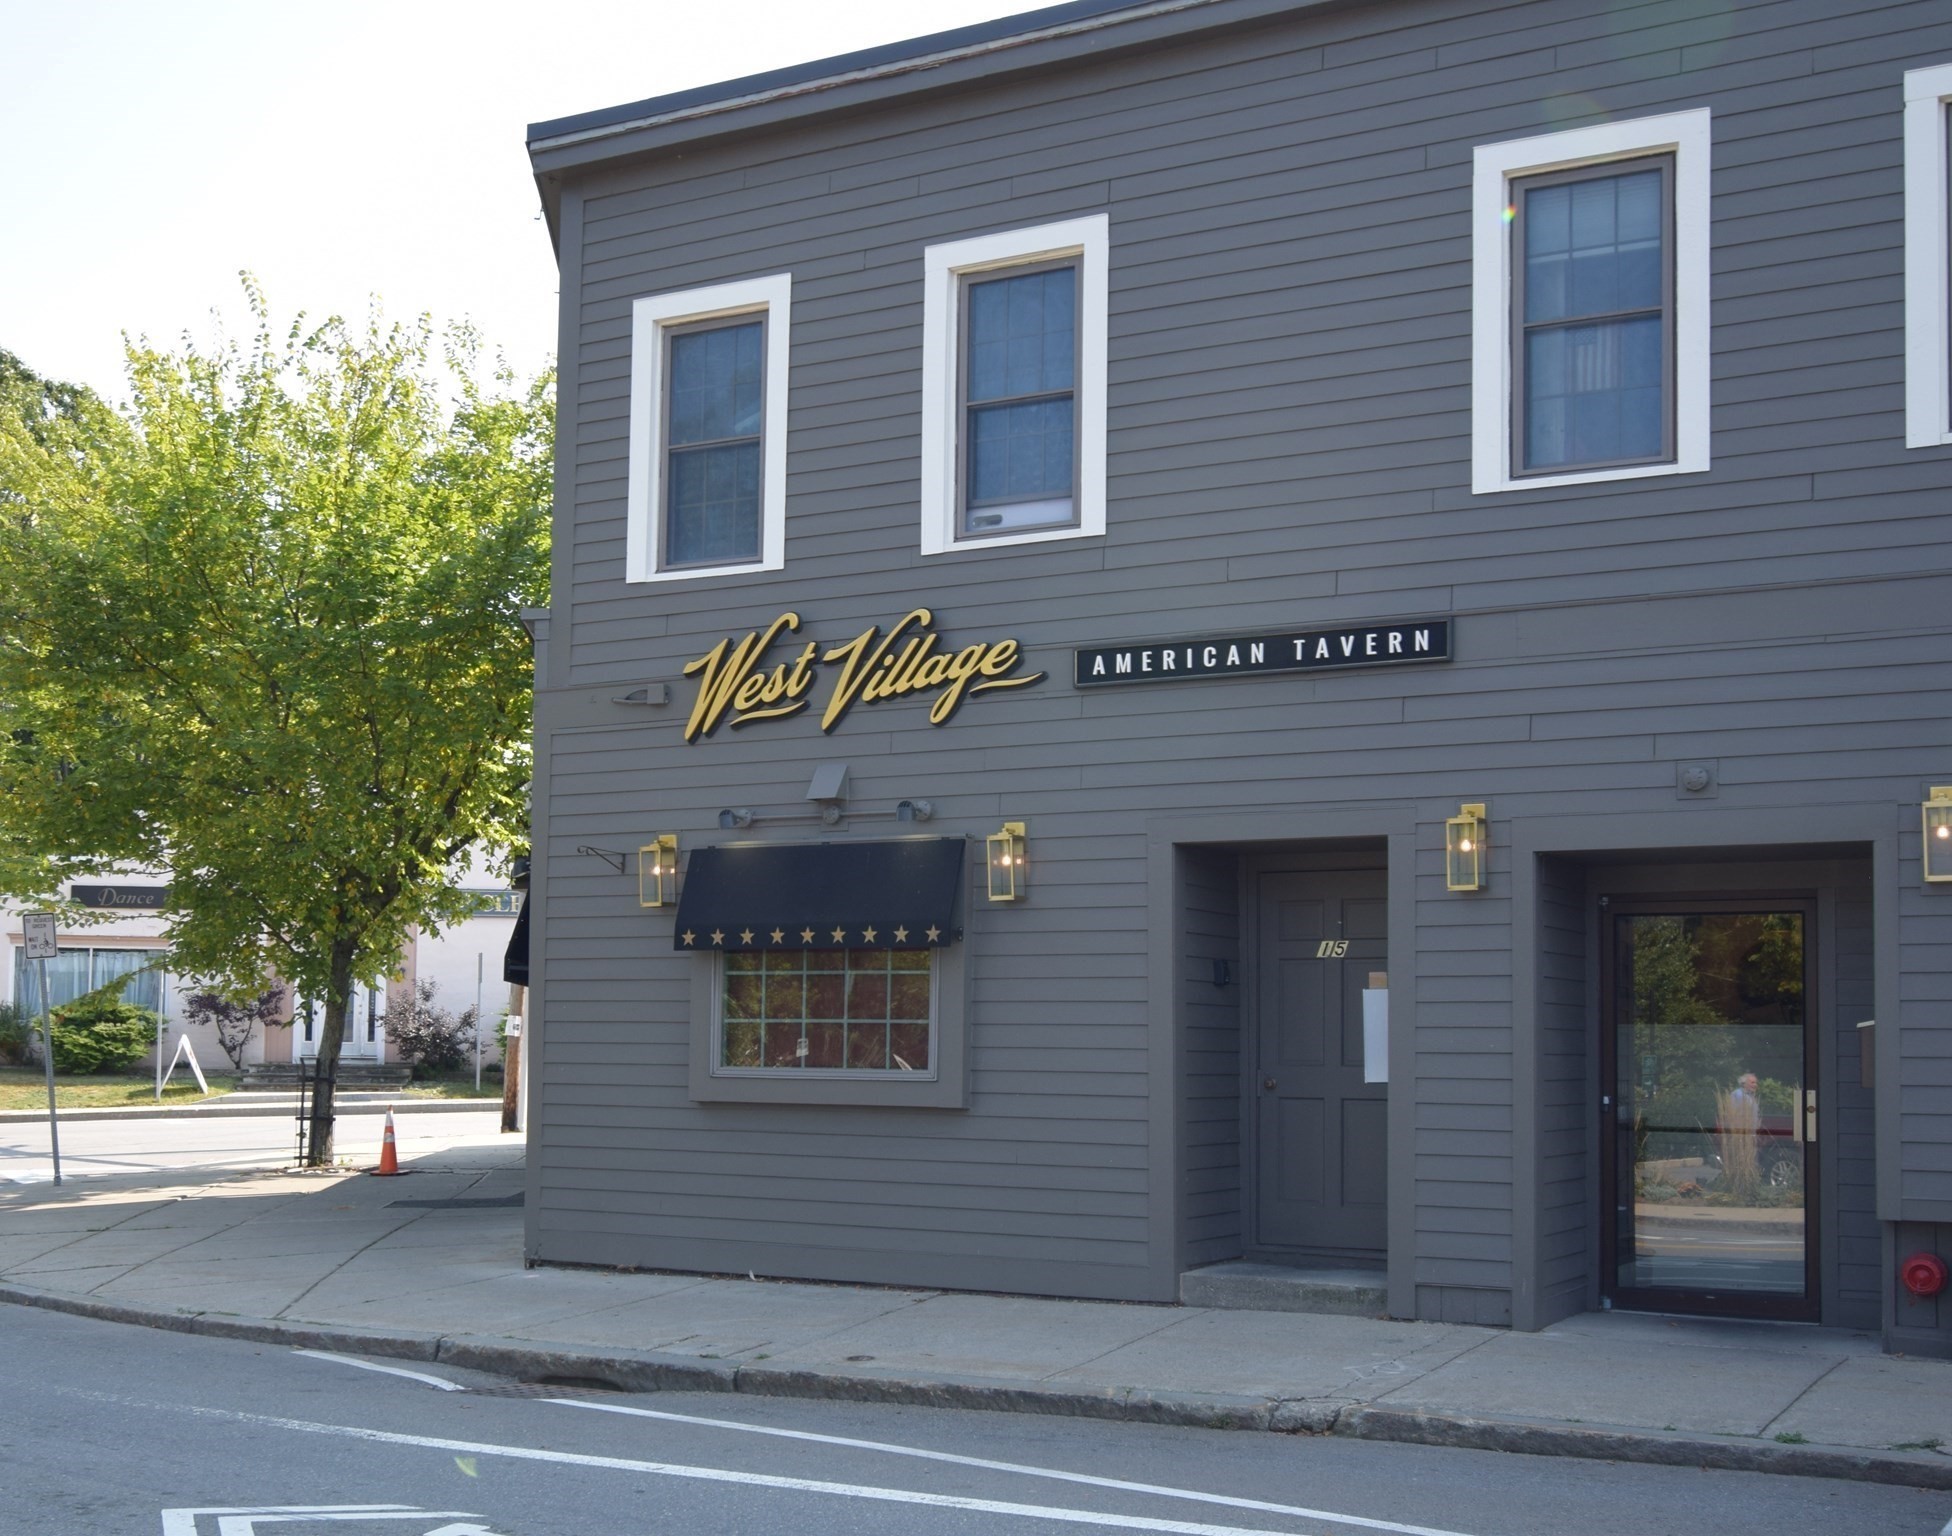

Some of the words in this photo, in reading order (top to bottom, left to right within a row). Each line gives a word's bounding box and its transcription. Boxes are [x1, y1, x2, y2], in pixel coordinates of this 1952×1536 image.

[1092, 642, 1265, 676] AMERICAN
[1293, 629, 1430, 661] TAVERN
[683, 611, 818, 744] West
[821, 607, 1046, 735] Village
[97, 887, 155, 907] Dance
[1322, 941, 1347, 957] 15
